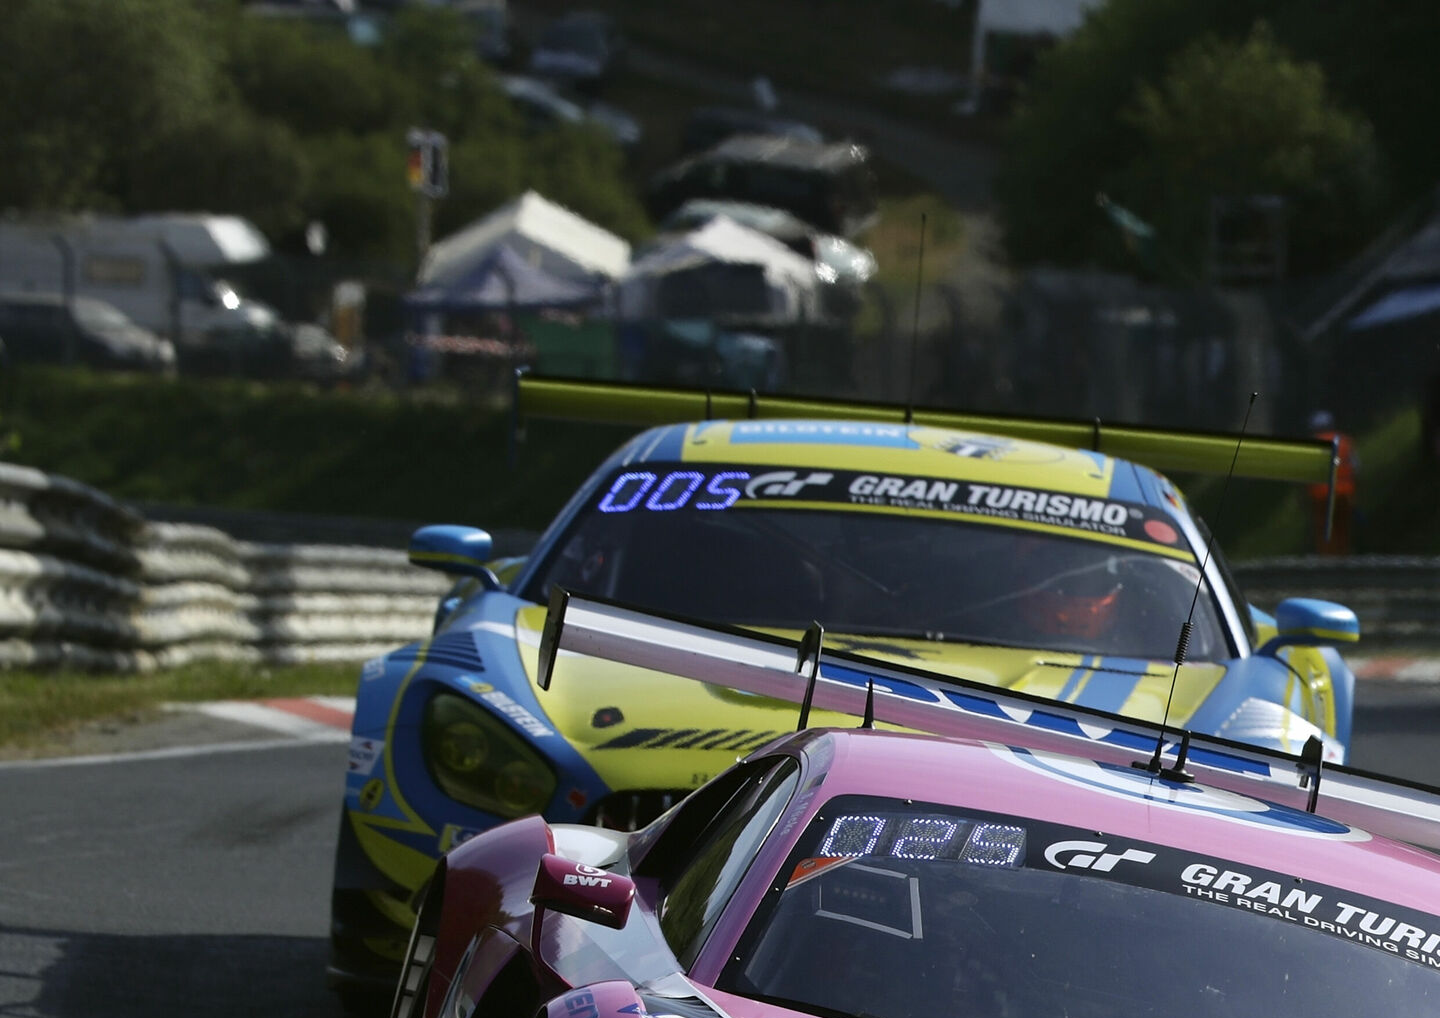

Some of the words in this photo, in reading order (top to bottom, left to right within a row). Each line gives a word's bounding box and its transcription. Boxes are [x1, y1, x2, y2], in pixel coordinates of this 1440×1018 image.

[598, 470, 751, 513] 005
[849, 475, 959, 502] GRAN
[967, 484, 1128, 527] TURISMO
[851, 494, 887, 507] THE
[890, 497, 939, 512] REAL
[943, 502, 1019, 521] DRIVING
[1023, 511, 1127, 537] SIMULATOR
[480, 690, 555, 737] BILSTEIN
[819, 815, 1024, 866] 025
[563, 873, 613, 888] BWT
[1180, 862, 1323, 914] GRAN
[1182, 883, 1230, 903] THE
[1236, 896, 1298, 921] REAL
[1303, 915, 1399, 953] DRIVING
